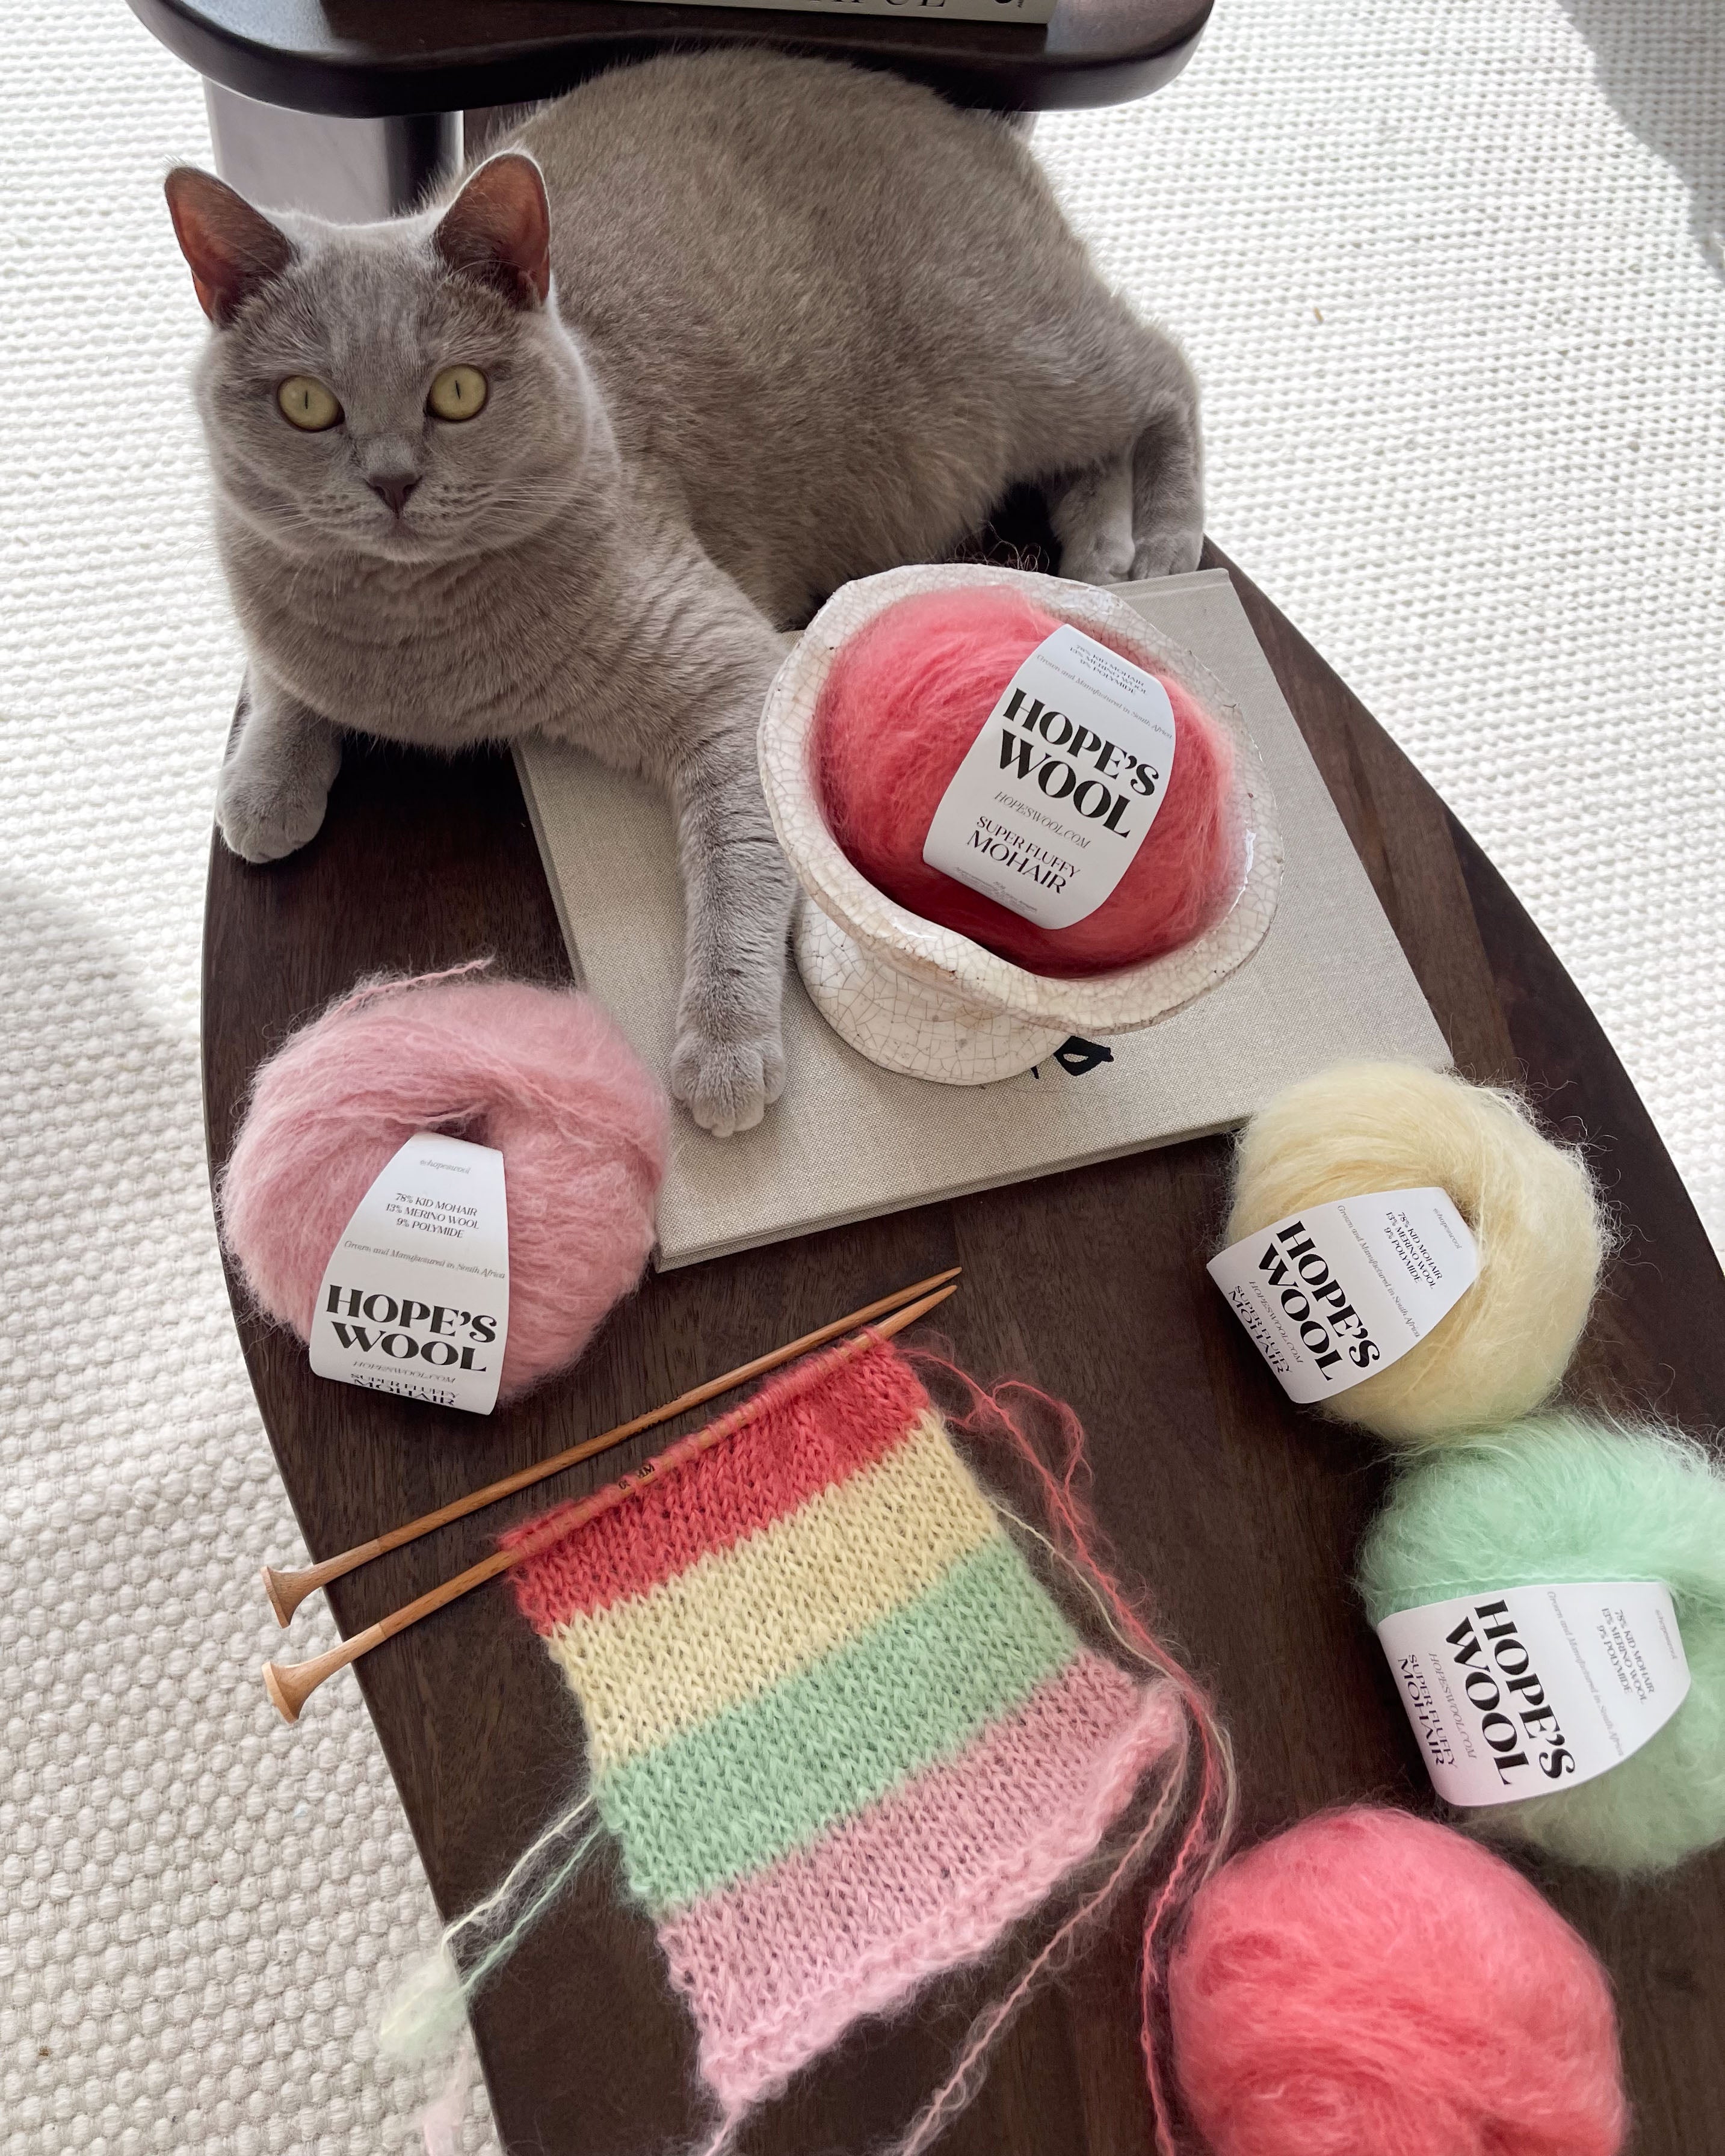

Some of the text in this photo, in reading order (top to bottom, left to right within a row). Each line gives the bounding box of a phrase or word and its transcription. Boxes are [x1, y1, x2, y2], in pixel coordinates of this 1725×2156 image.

[1061, 670, 1076, 680] and
[1123, 706, 1130, 714] in
[1003, 688, 1159, 796] HOPE'S
[999, 728, 1131, 838] WOOL
[977, 816, 1081, 878] SUPER FLUFFY
[995, 792, 1091, 849] HOPESWOOL.COM
[967, 830, 1066, 894] MOHAIR
[386, 1203, 480, 1229] 13% MERINO WOOL
[395, 1193, 478, 1216] 78% KID MOHAIR
[397, 1218, 464, 1238] 9% POLYMIDE
[373, 1247, 390, 1256] and
[446, 1261, 455, 1269] in
[1352, 1228, 1364, 1242] and
[1387, 1287, 1395, 1296] in
[1384, 1227, 1423, 1284] 9% POLYMIDE
[1386, 1212, 1436, 1290] 13% MERINO WOOL
[1398, 1212, 1443, 1280] 78% KID MOHAIR
[326, 1284, 497, 1343] HOPE'S
[1235, 1286, 1292, 1373] SUPER FLUFFY
[1248, 1281, 1304, 1363] HOPESWOOL.COM
[1258, 1243, 1343, 1381] WOOL
[1276, 1220, 1380, 1369] HOPE'S
[331, 1321, 487, 1372] WOOL
[1228, 1290, 1283, 1373] MOHAIR
[1398, 1659, 1445, 1765] MOHAIR
[1409, 1654, 1458, 1769] SUPER FLUFFY
[1428, 1652, 1477, 1759] HOPESWOOL.COM
[1446, 1616, 1529, 1785] WOOL
[1474, 1599, 1575, 1779] HOPE'S
